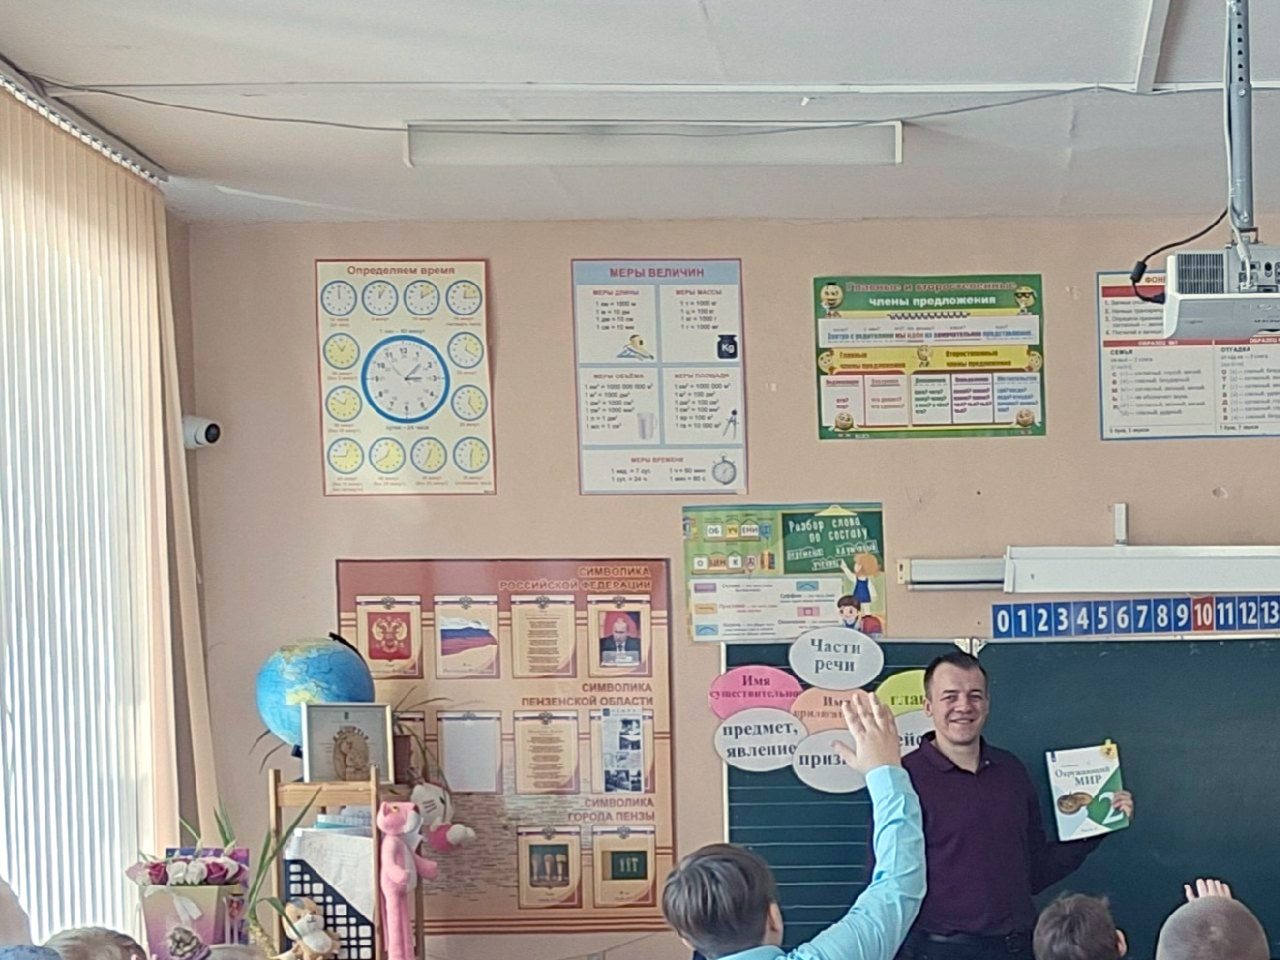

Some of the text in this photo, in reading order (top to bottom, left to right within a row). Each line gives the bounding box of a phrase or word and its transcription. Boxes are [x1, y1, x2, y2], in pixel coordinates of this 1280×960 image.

[347, 265, 456, 277] Определяем время
[609, 267, 705, 278] МЕРЫ ВЕЛИЧИН
[869, 295, 997, 308] члены предложения
[721, 343, 736, 354] Kg
[789, 516, 861, 534] Разбор слова
[809, 527, 868, 543] по составу
[579, 566, 650, 577] СИМВОЛИКА
[500, 579, 652, 591] РОССИЙСКОЙ ФЕДЕРАЦИИ
[997, 610, 1010, 633] 0
[1017, 609, 1027, 632] 1
[1037, 608, 1049, 631] 2
[1057, 607, 1069, 630] 3
[1076, 607, 1090, 630] 4
[1097, 606, 1108, 629] 5
[1116, 606, 1129, 629] 6
[1136, 605, 1148, 628] 7
[1156, 604, 1168, 627] 8
[1176, 604, 1189, 627] 9
[1194, 603, 1213, 626] 10
[1217, 602, 1234, 625] 11
[1239, 601, 1257, 624] 12
[1261, 601, 1279, 624] 13
[810, 638, 861, 655] Части
[814, 658, 855, 674] речи
[742, 675, 770, 687] Имя
[582, 683, 652, 693] СИМВОЛИКА
[522, 695, 653, 706] ПЕНЗЕНСКОЙ ОБЛАСТИ
[723, 723, 798, 739] предмет,
[726, 743, 798, 759] явление
[1075, 775, 1102, 786] МИР
[584, 798, 654, 808] СИМВОЛИКА
[1099, 791, 1125, 825] 2
[568, 811, 656, 821] ГОРОДА ПЕНЗЫ
